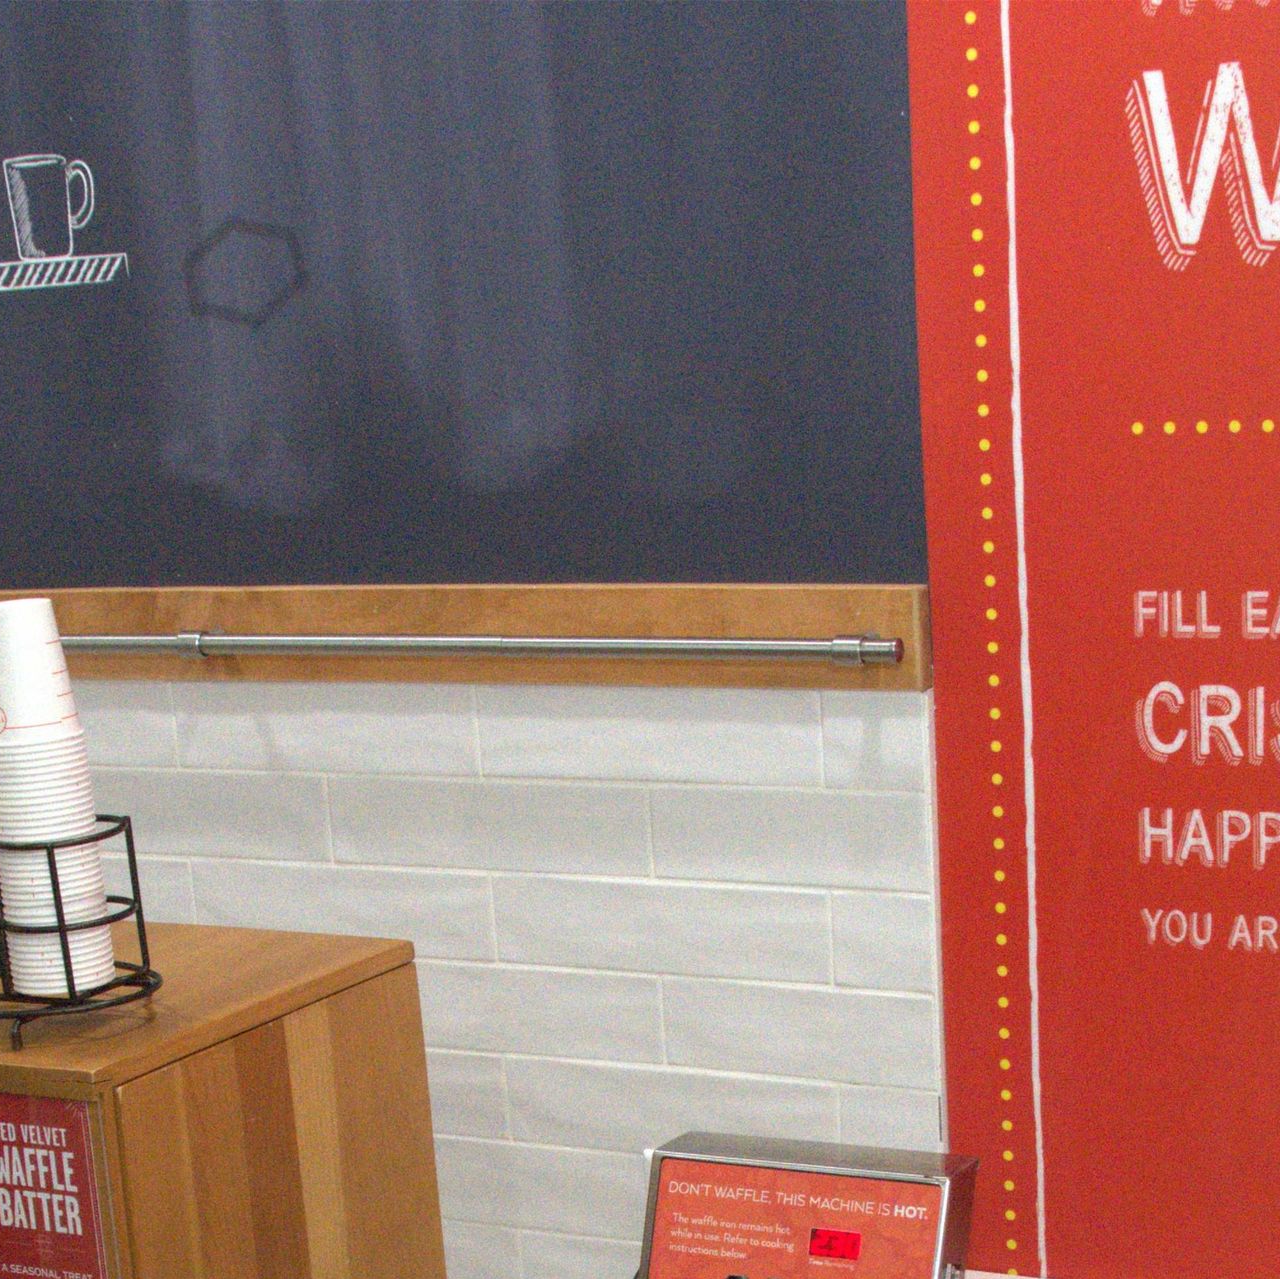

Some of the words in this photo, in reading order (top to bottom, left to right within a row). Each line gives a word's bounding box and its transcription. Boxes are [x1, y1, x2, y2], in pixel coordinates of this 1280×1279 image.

[1134, 590, 1220, 638] FILL
[1140, 908, 1212, 950] YOU
[20, 1124, 67, 1147] VELVET
[668, 1180, 712, 1197] DON'T
[776, 1191, 806, 1207] THIS
[809, 1196, 874, 1215] MACHINE
[878, 1202, 891, 1216] IS
[894, 1205, 928, 1220] HOT.
[673, 1212, 689, 1223] The
[691, 1215, 718, 1226] waffle
[739, 1222, 773, 1233] remains
[671, 1228, 692, 1239] while
[723, 1232, 747, 1245] Refer
[750, 1237, 759, 1246] to
[669, 1241, 719, 1256] instructions
[1, 1263, 8, 1272] A
[9, 1264, 61, 1279] SEASONAL
